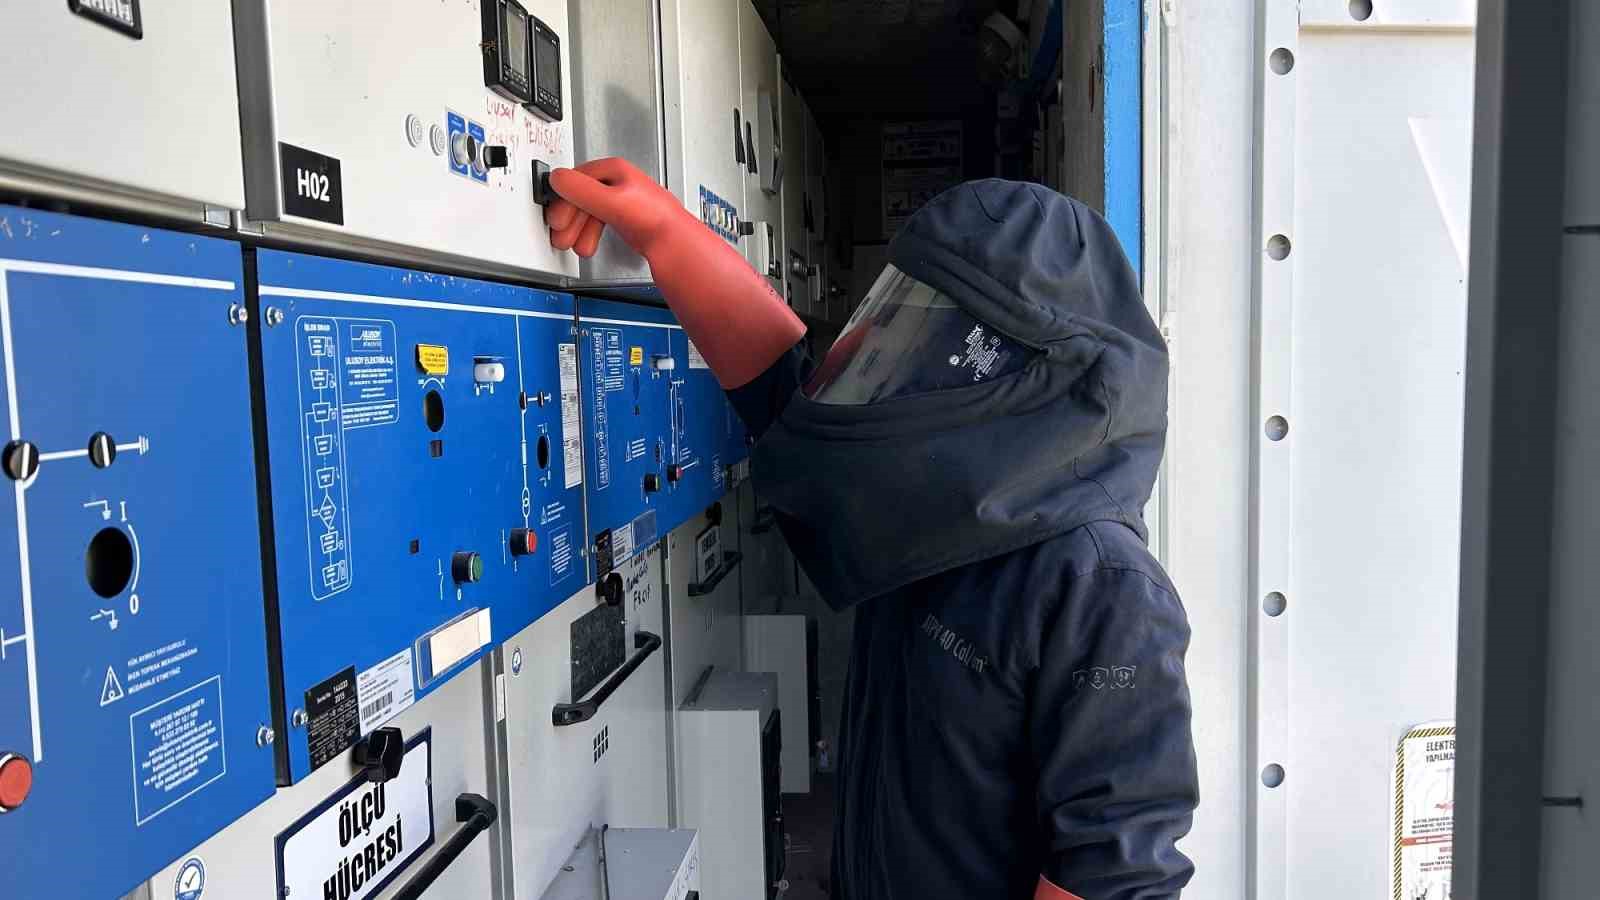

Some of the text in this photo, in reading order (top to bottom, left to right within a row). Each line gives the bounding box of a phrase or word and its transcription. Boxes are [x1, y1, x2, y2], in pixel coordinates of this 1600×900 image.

[297, 168, 330, 202] H02
[129, 594, 139, 614] 0
[941, 629, 956, 651] 40
[338, 781, 385, 848] ÖLÇÜ
[323, 813, 403, 900] HÜCRESİ
